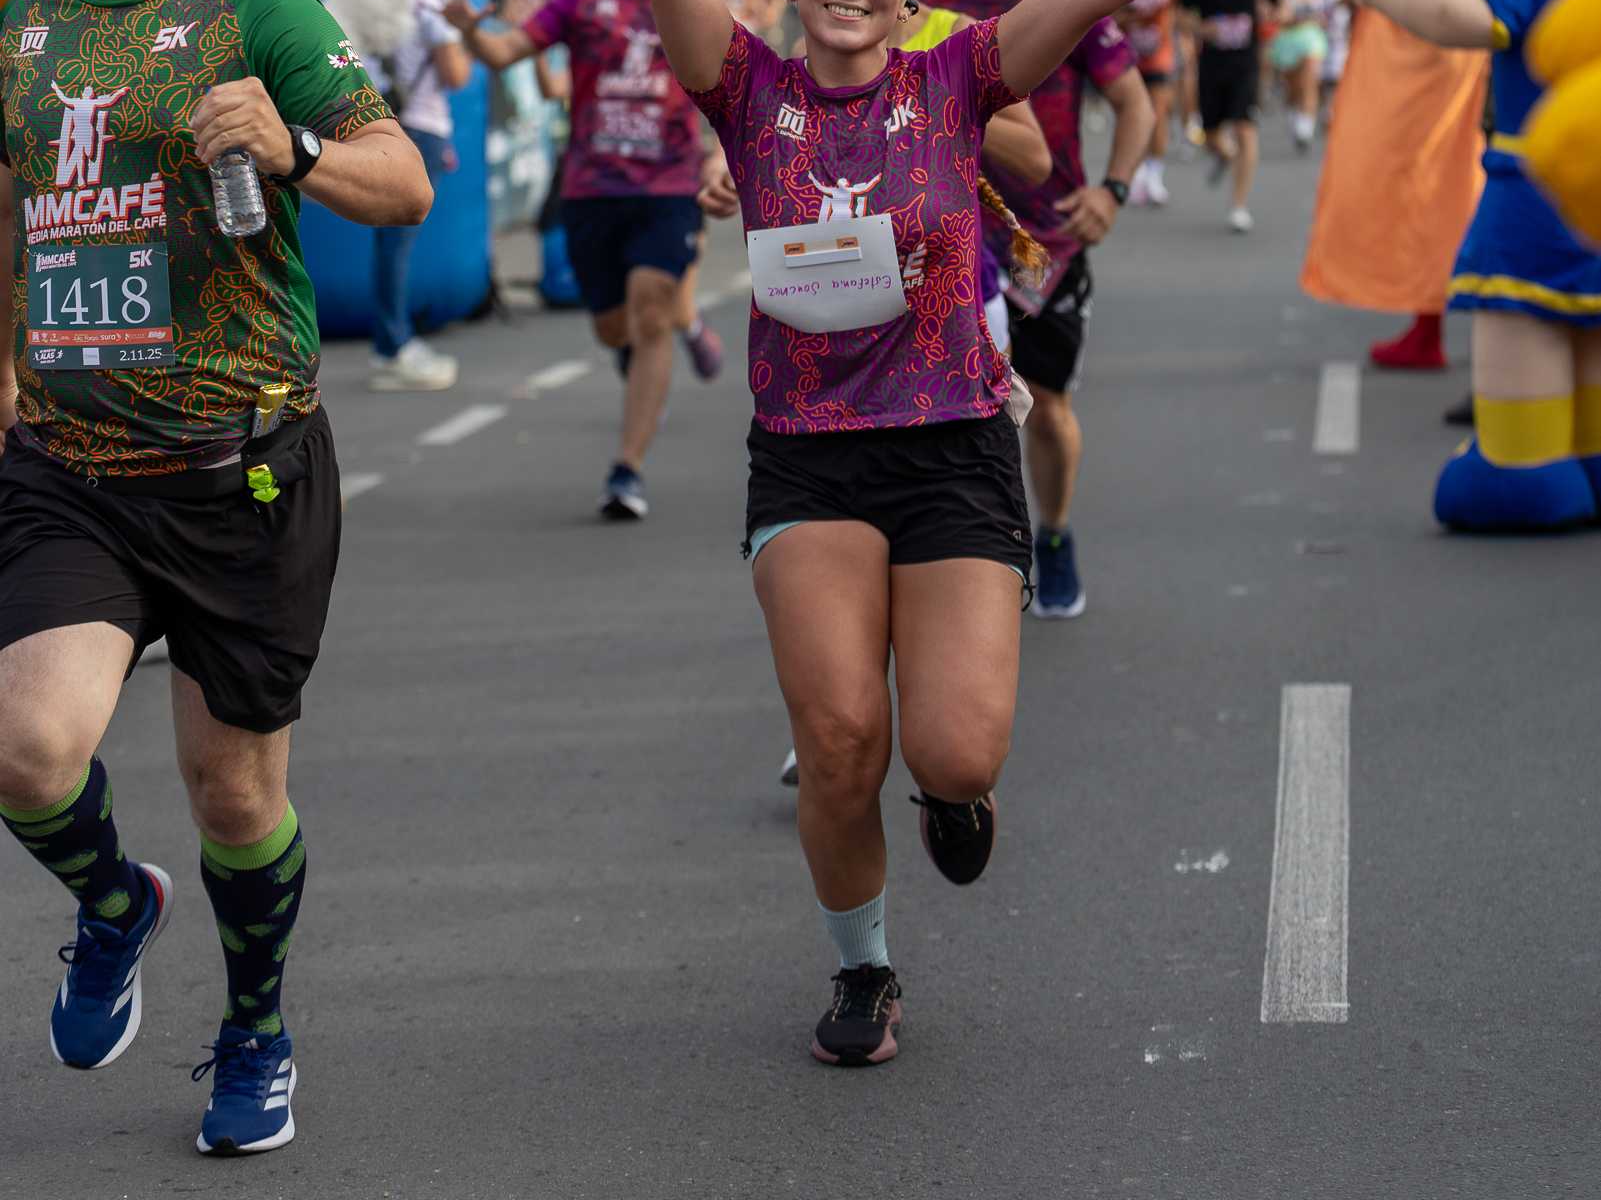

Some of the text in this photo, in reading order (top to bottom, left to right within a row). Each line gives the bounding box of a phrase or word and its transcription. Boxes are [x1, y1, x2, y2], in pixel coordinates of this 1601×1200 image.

[152, 20, 201, 53] 5K
[24, 172, 166, 231] MMCAFÉ
[50, 220, 106, 239] MARATÓN
[109, 219, 131, 233] DEL
[134, 211, 167, 230] CAFÉ
[40, 249, 77, 267] MMCAFÉ
[129, 248, 153, 269] 5K
[903, 272, 925, 289] AFÉ
[39, 275, 151, 325] 1418
[119, 347, 163, 362] 2.11.25
